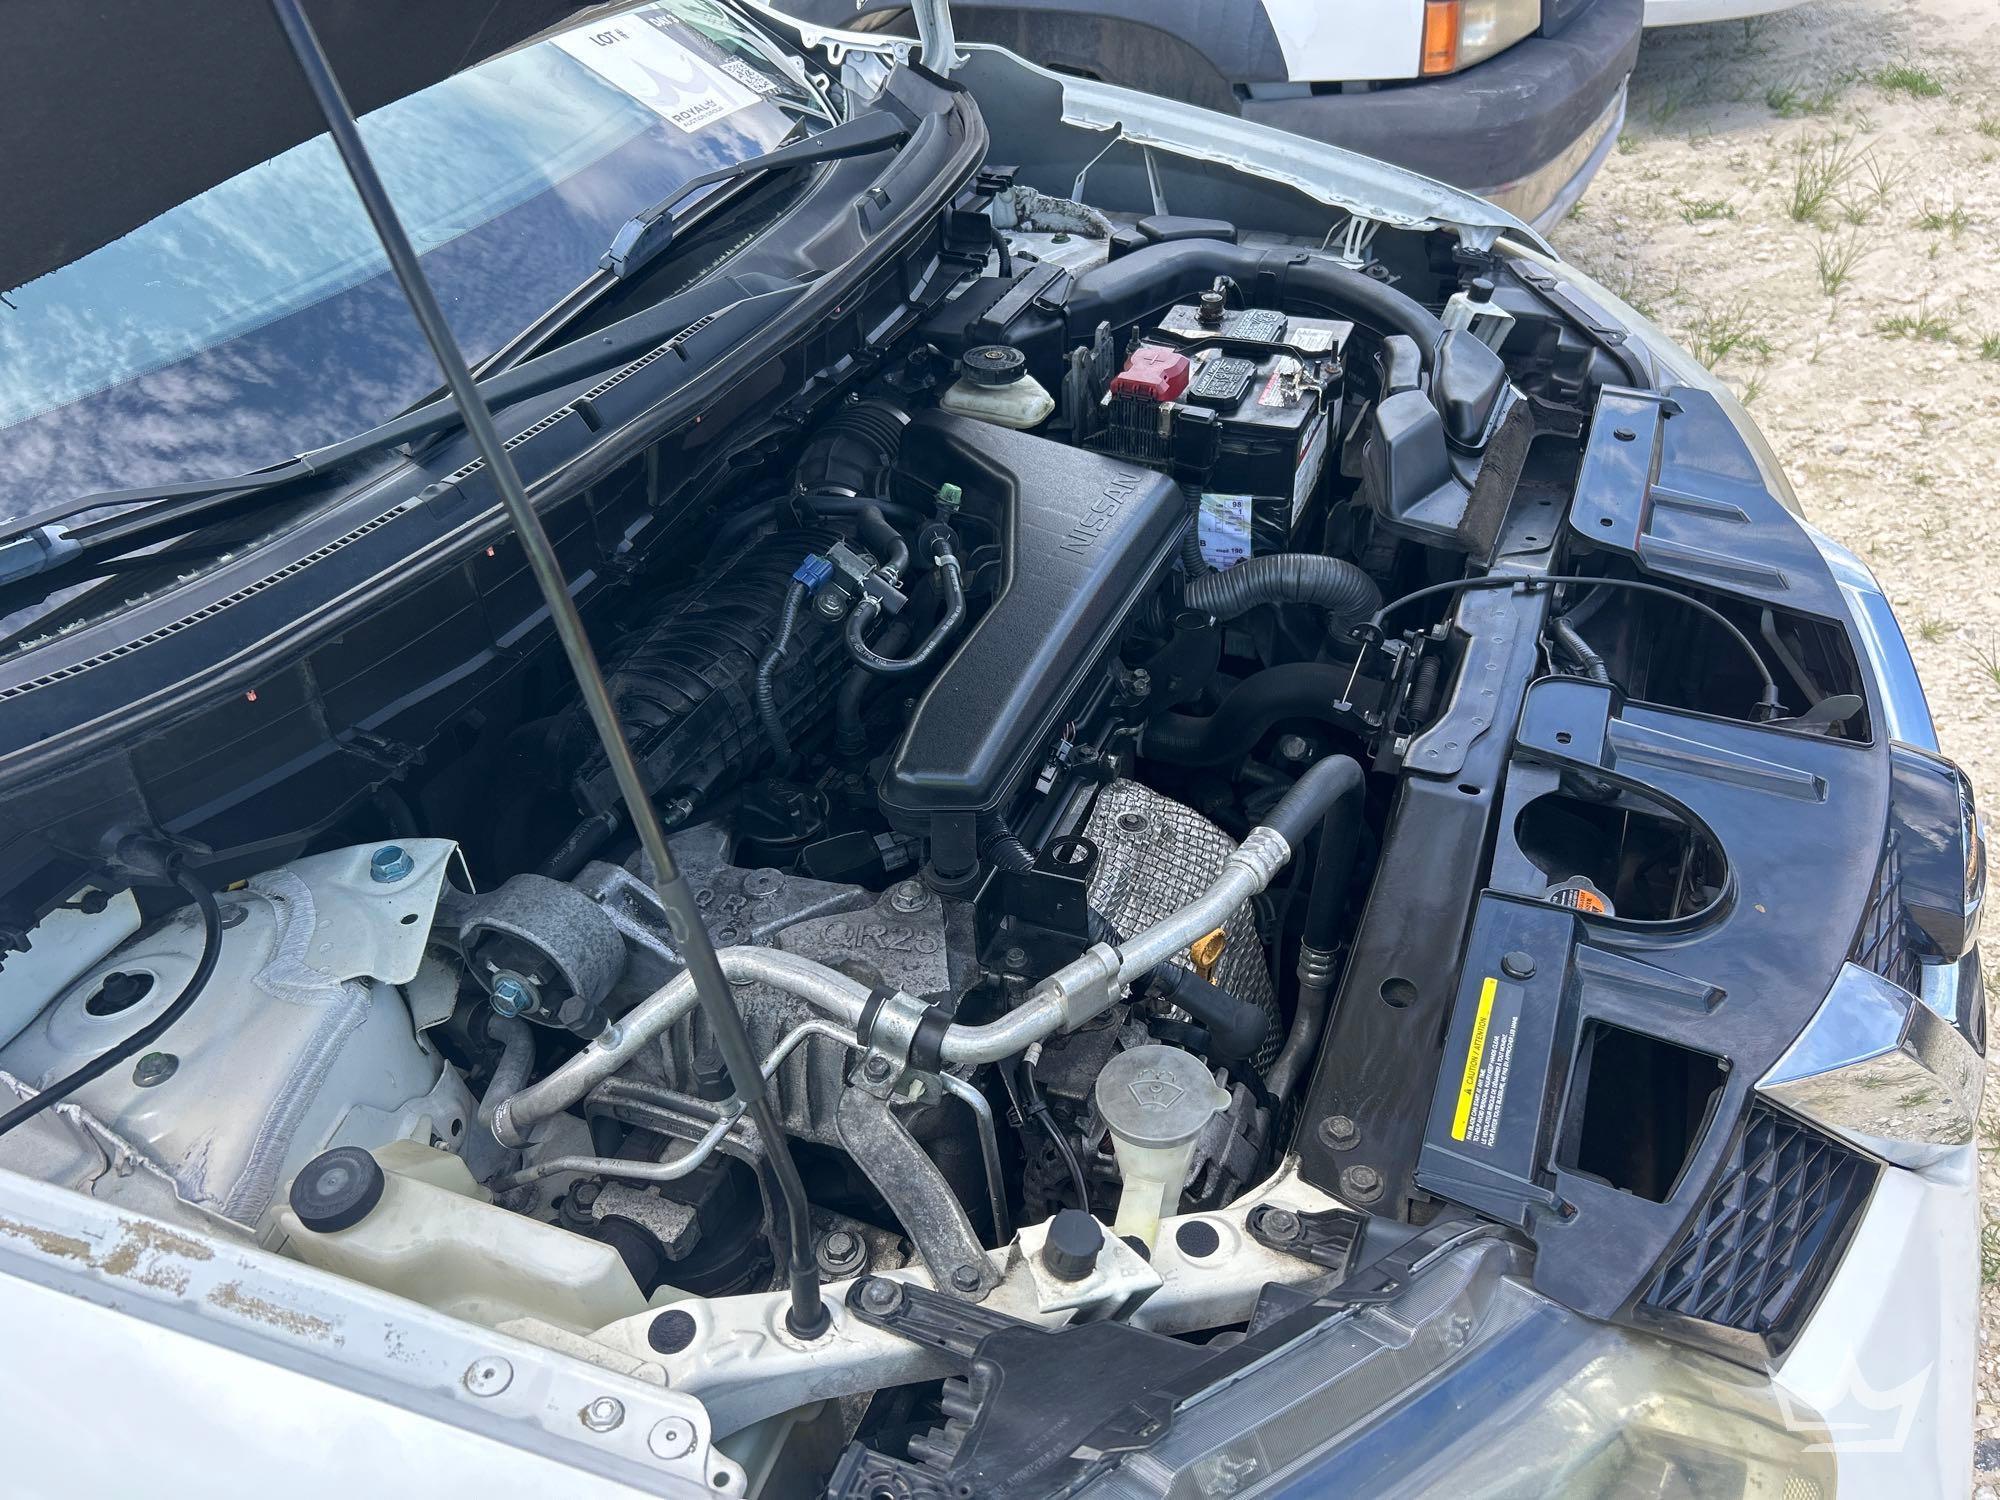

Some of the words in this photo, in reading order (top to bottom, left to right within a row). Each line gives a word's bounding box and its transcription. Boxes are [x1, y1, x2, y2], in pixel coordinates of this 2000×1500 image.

[589, 31, 620, 46] LOT
[672, 103, 711, 123] ROYAL
[1060, 472, 1142, 555] NISSAN
[820, 921, 939, 954] QR25
[1467, 1056, 1478, 1084] CAUTION
[1474, 1017, 1486, 1050] ATTENTION
[1480, 1089, 1489, 1110] PERSONAL
[1493, 1105, 1501, 1118] TOUTE
[1482, 1111, 1492, 1138] VENTILATEUR
[1487, 1095, 1496, 1111] RISQUE
